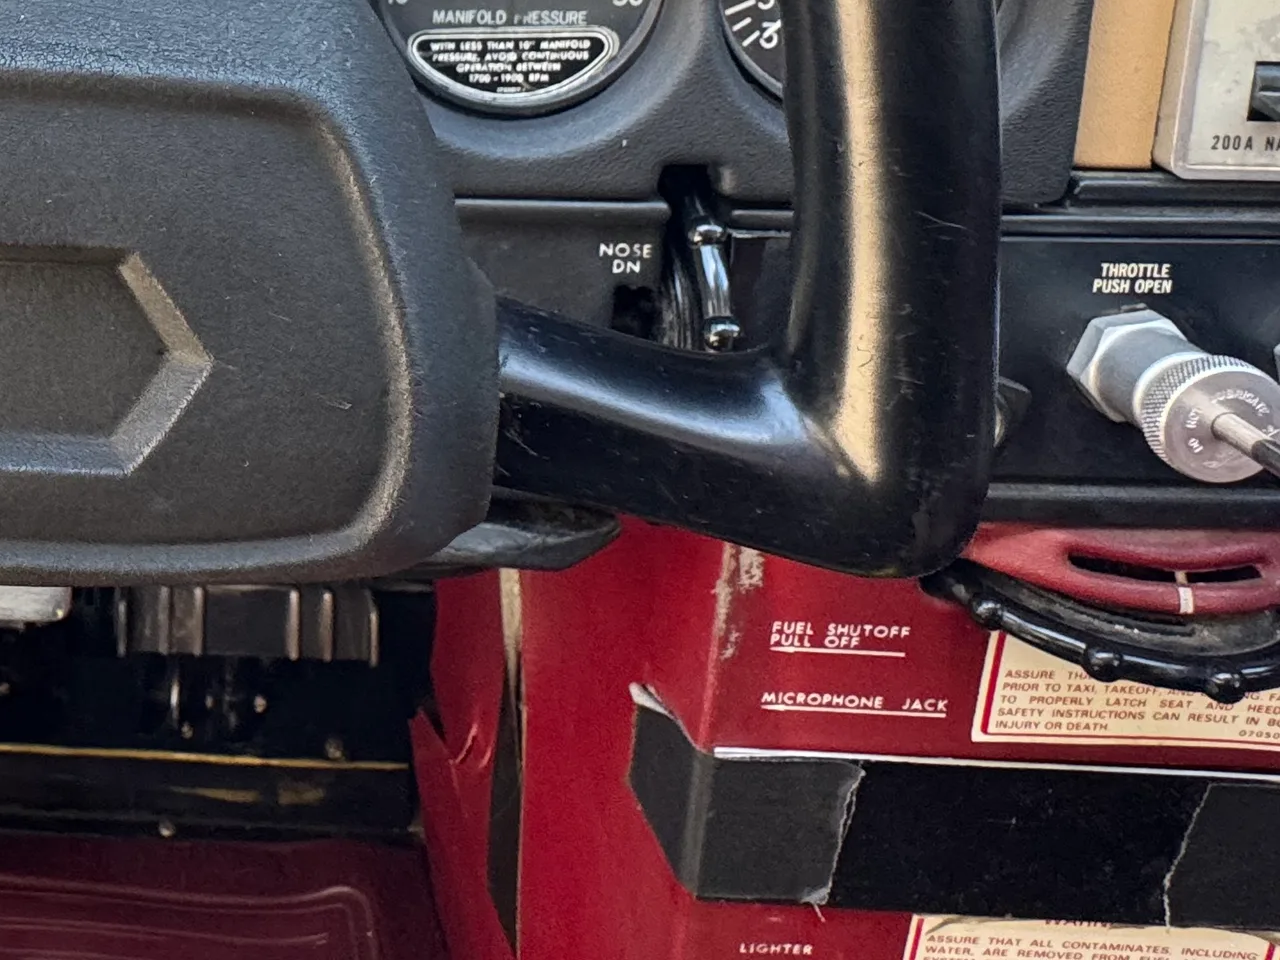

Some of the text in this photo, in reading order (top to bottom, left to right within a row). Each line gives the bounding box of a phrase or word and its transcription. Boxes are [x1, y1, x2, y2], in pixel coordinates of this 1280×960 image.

[431, 8, 508, 25] MANIFOLD
[459, 40, 483, 51] LESS
[486, 40, 515, 51] THAN
[539, 39, 591, 50] MANIFOLD
[484, 51, 518, 62] AVOID
[521, 50, 590, 61] CONTINUOUS
[455, 62, 562, 74] OPERATION BETWEEN
[1210, 135, 1254, 151] 200A
[598, 242, 653, 259] NOSE
[611, 258, 642, 274] DN
[1100, 262, 1171, 279] THROTTLE
[1092, 278, 1173, 294] PUSH OPEN
[771, 620, 912, 639] FUEL SHUTOFF
[770, 634, 861, 649] PULL OFF
[1004, 669, 1056, 680] ASSURE
[1002, 682, 1040, 692] PRIOR
[1044, 683, 1062, 693] TO
[1067, 684, 1098, 695] TAXI,
[761, 691, 950, 713] MICROPHONE JACK
[1000, 695, 1018, 705] TO
[1028, 695, 1094, 707] PROPERLY
[1105, 697, 1147, 708] LATCH
[1159, 699, 1194, 709] SEAT
[997, 707, 1261, 726] SAFETY INSTRUCTIONS CAN RESULT IN
[995, 720, 1063, 731] INJURY OR
[739, 943, 814, 955] LIGHTER
[926, 934, 981, 945] ASSURE
[987, 936, 1023, 947] THAT
[1029, 939, 1054, 948] ALL
[1180, 947, 1259, 960] INCLUDING
[982, 948, 1009, 957] ARE
[1016, 949, 1083, 960] REMOVED
